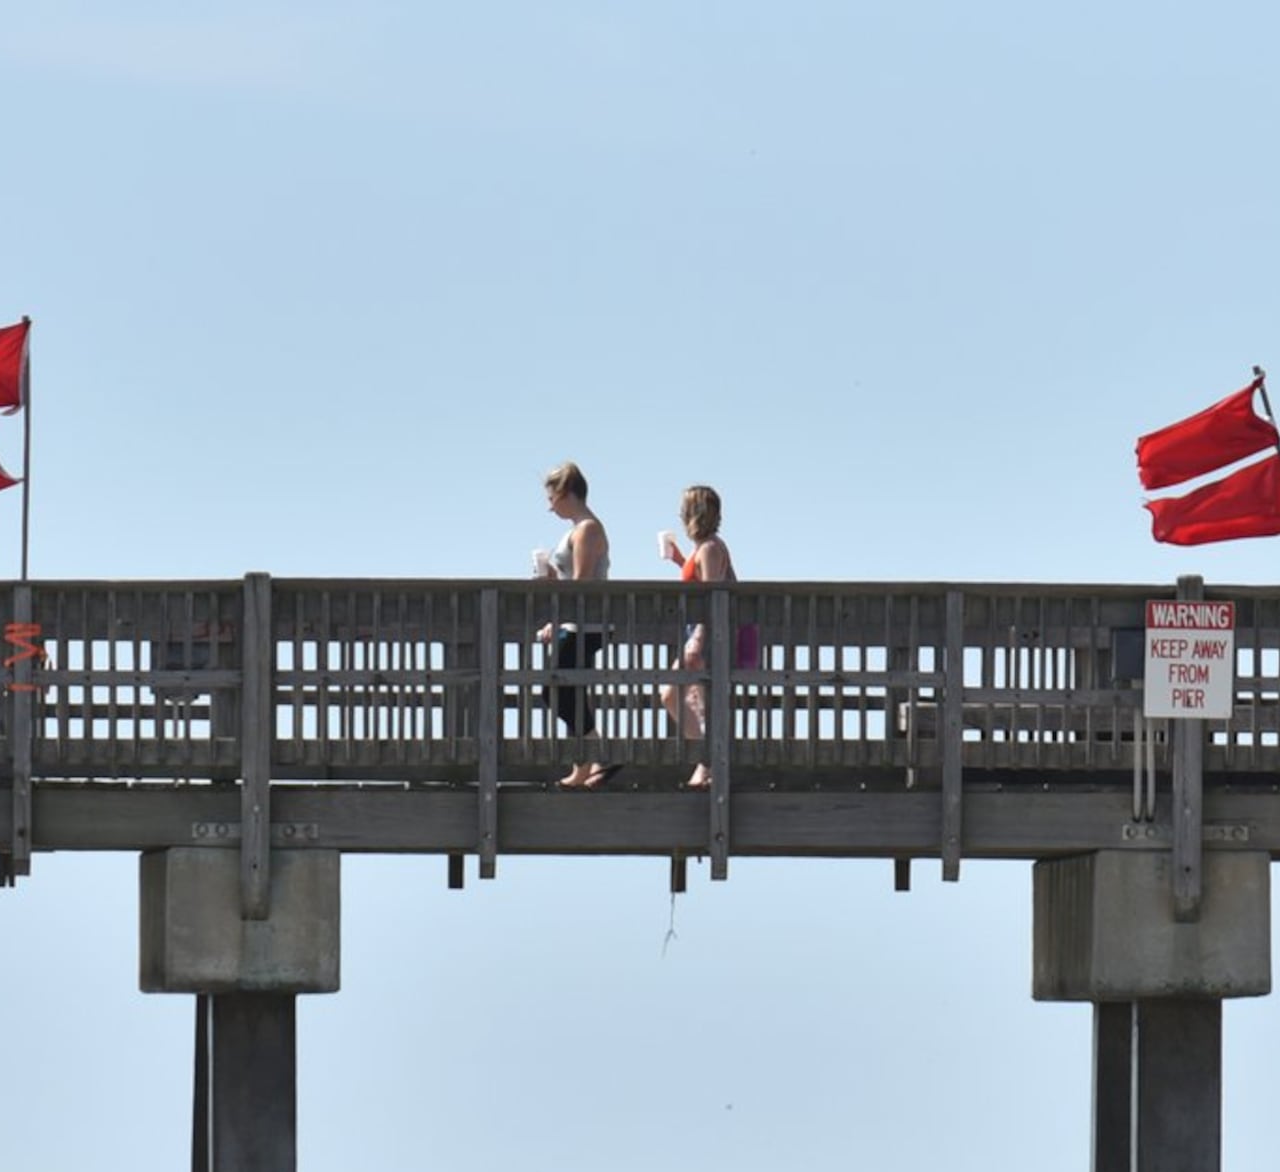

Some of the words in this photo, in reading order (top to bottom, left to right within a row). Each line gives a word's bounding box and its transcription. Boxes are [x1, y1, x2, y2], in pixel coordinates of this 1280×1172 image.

[1152, 604, 1229, 627] WARNING
[1151, 639, 1188, 658] KEEP
[1192, 640, 1227, 659] AWAY
[1169, 664, 1209, 684] FROM
[1172, 689, 1205, 708] PIER
